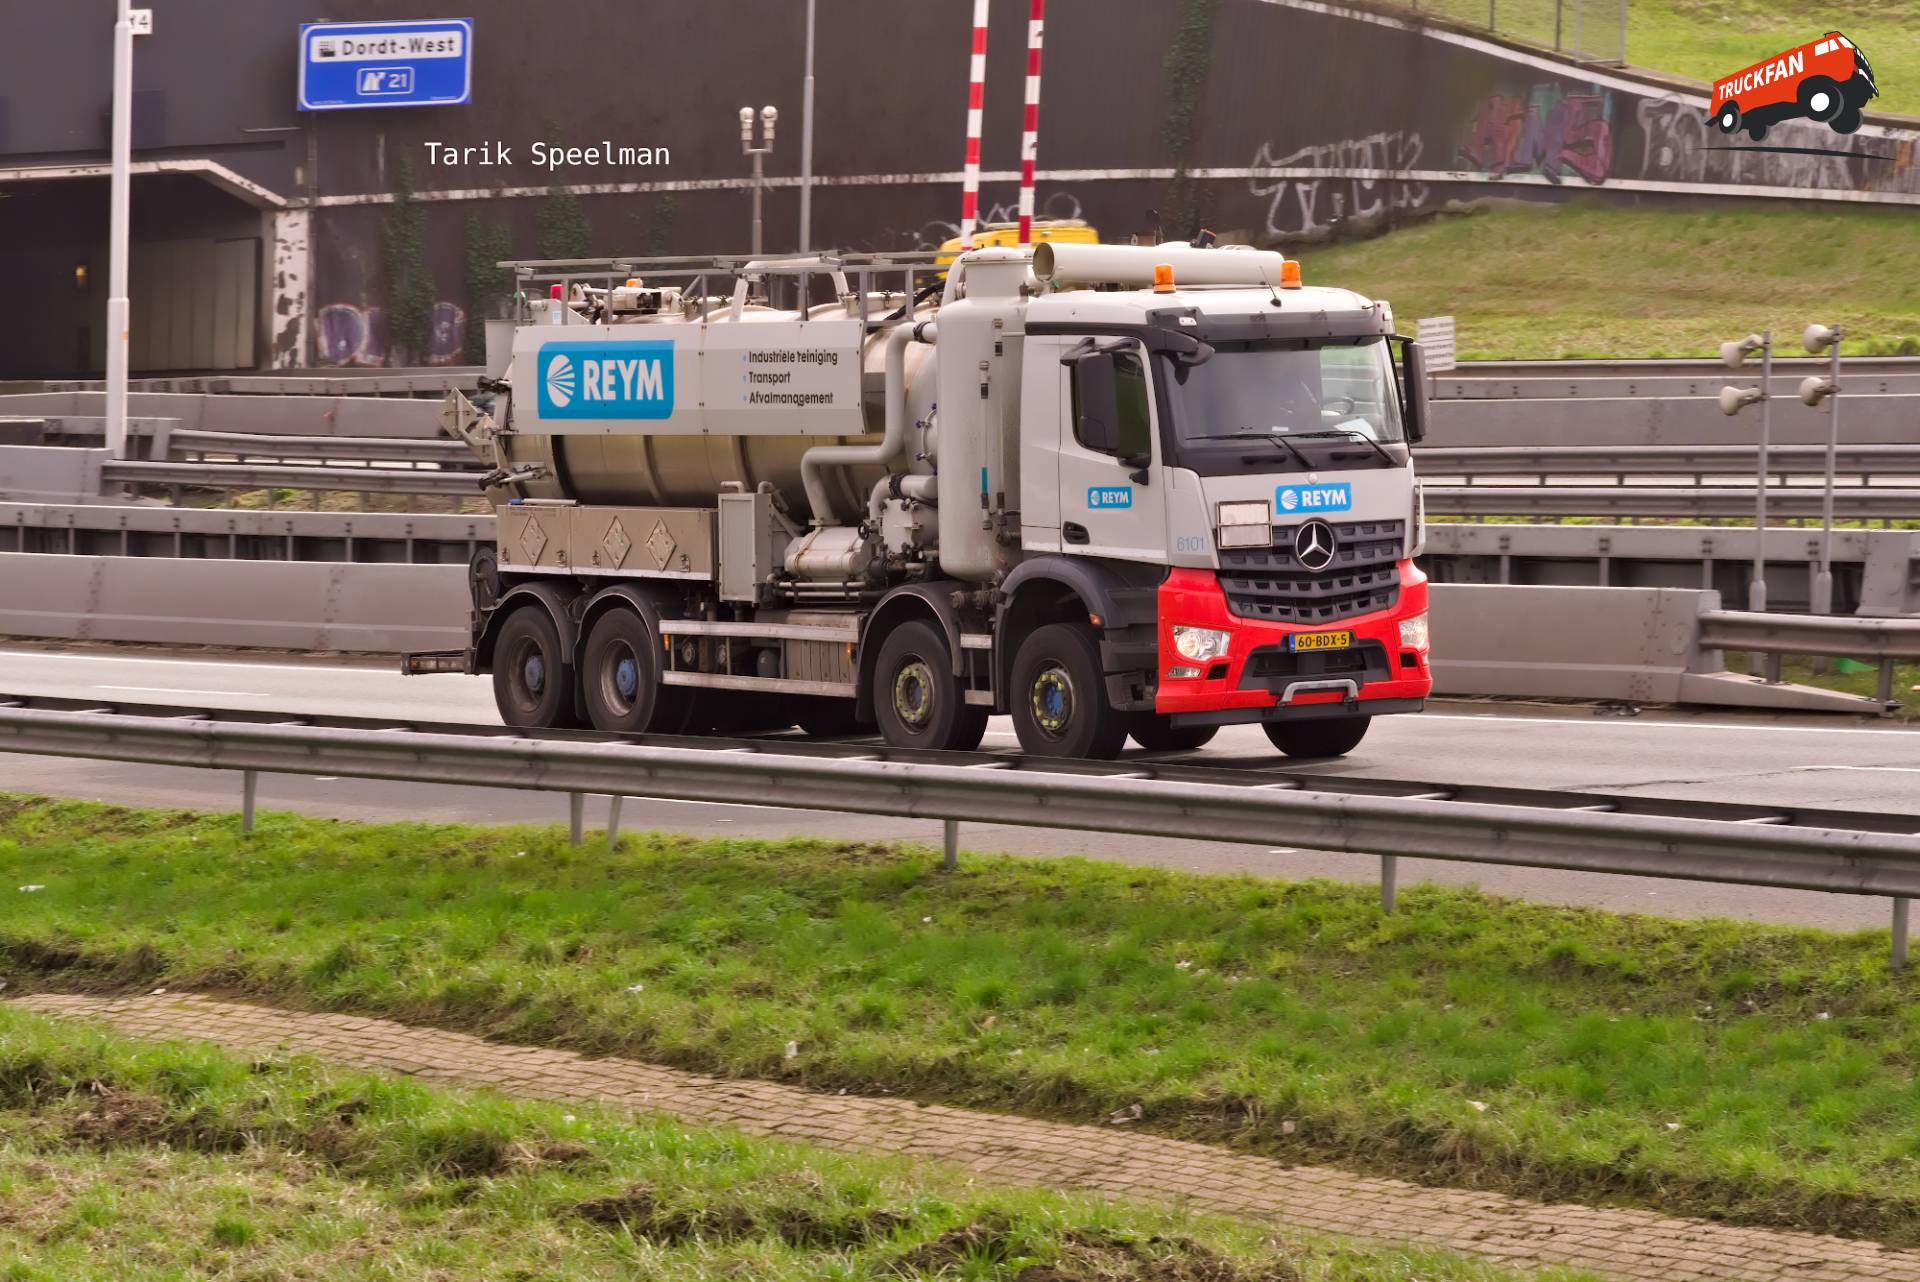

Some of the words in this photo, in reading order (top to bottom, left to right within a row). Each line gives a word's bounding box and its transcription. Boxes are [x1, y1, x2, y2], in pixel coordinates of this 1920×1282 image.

[342, 37, 456, 56] Dordt-West
[388, 73, 408, 88] 21
[797, 349, 838, 366] reiniging
[583, 359, 664, 400] REYM
[749, 371, 791, 386] Transport
[749, 391, 834, 407] Afvalmanagement
[1102, 491, 1129, 504] REYM
[1301, 489, 1347, 507] REYM
[1177, 536, 1205, 552] 6101
[1298, 634, 1347, 648] 60-BDX-5
